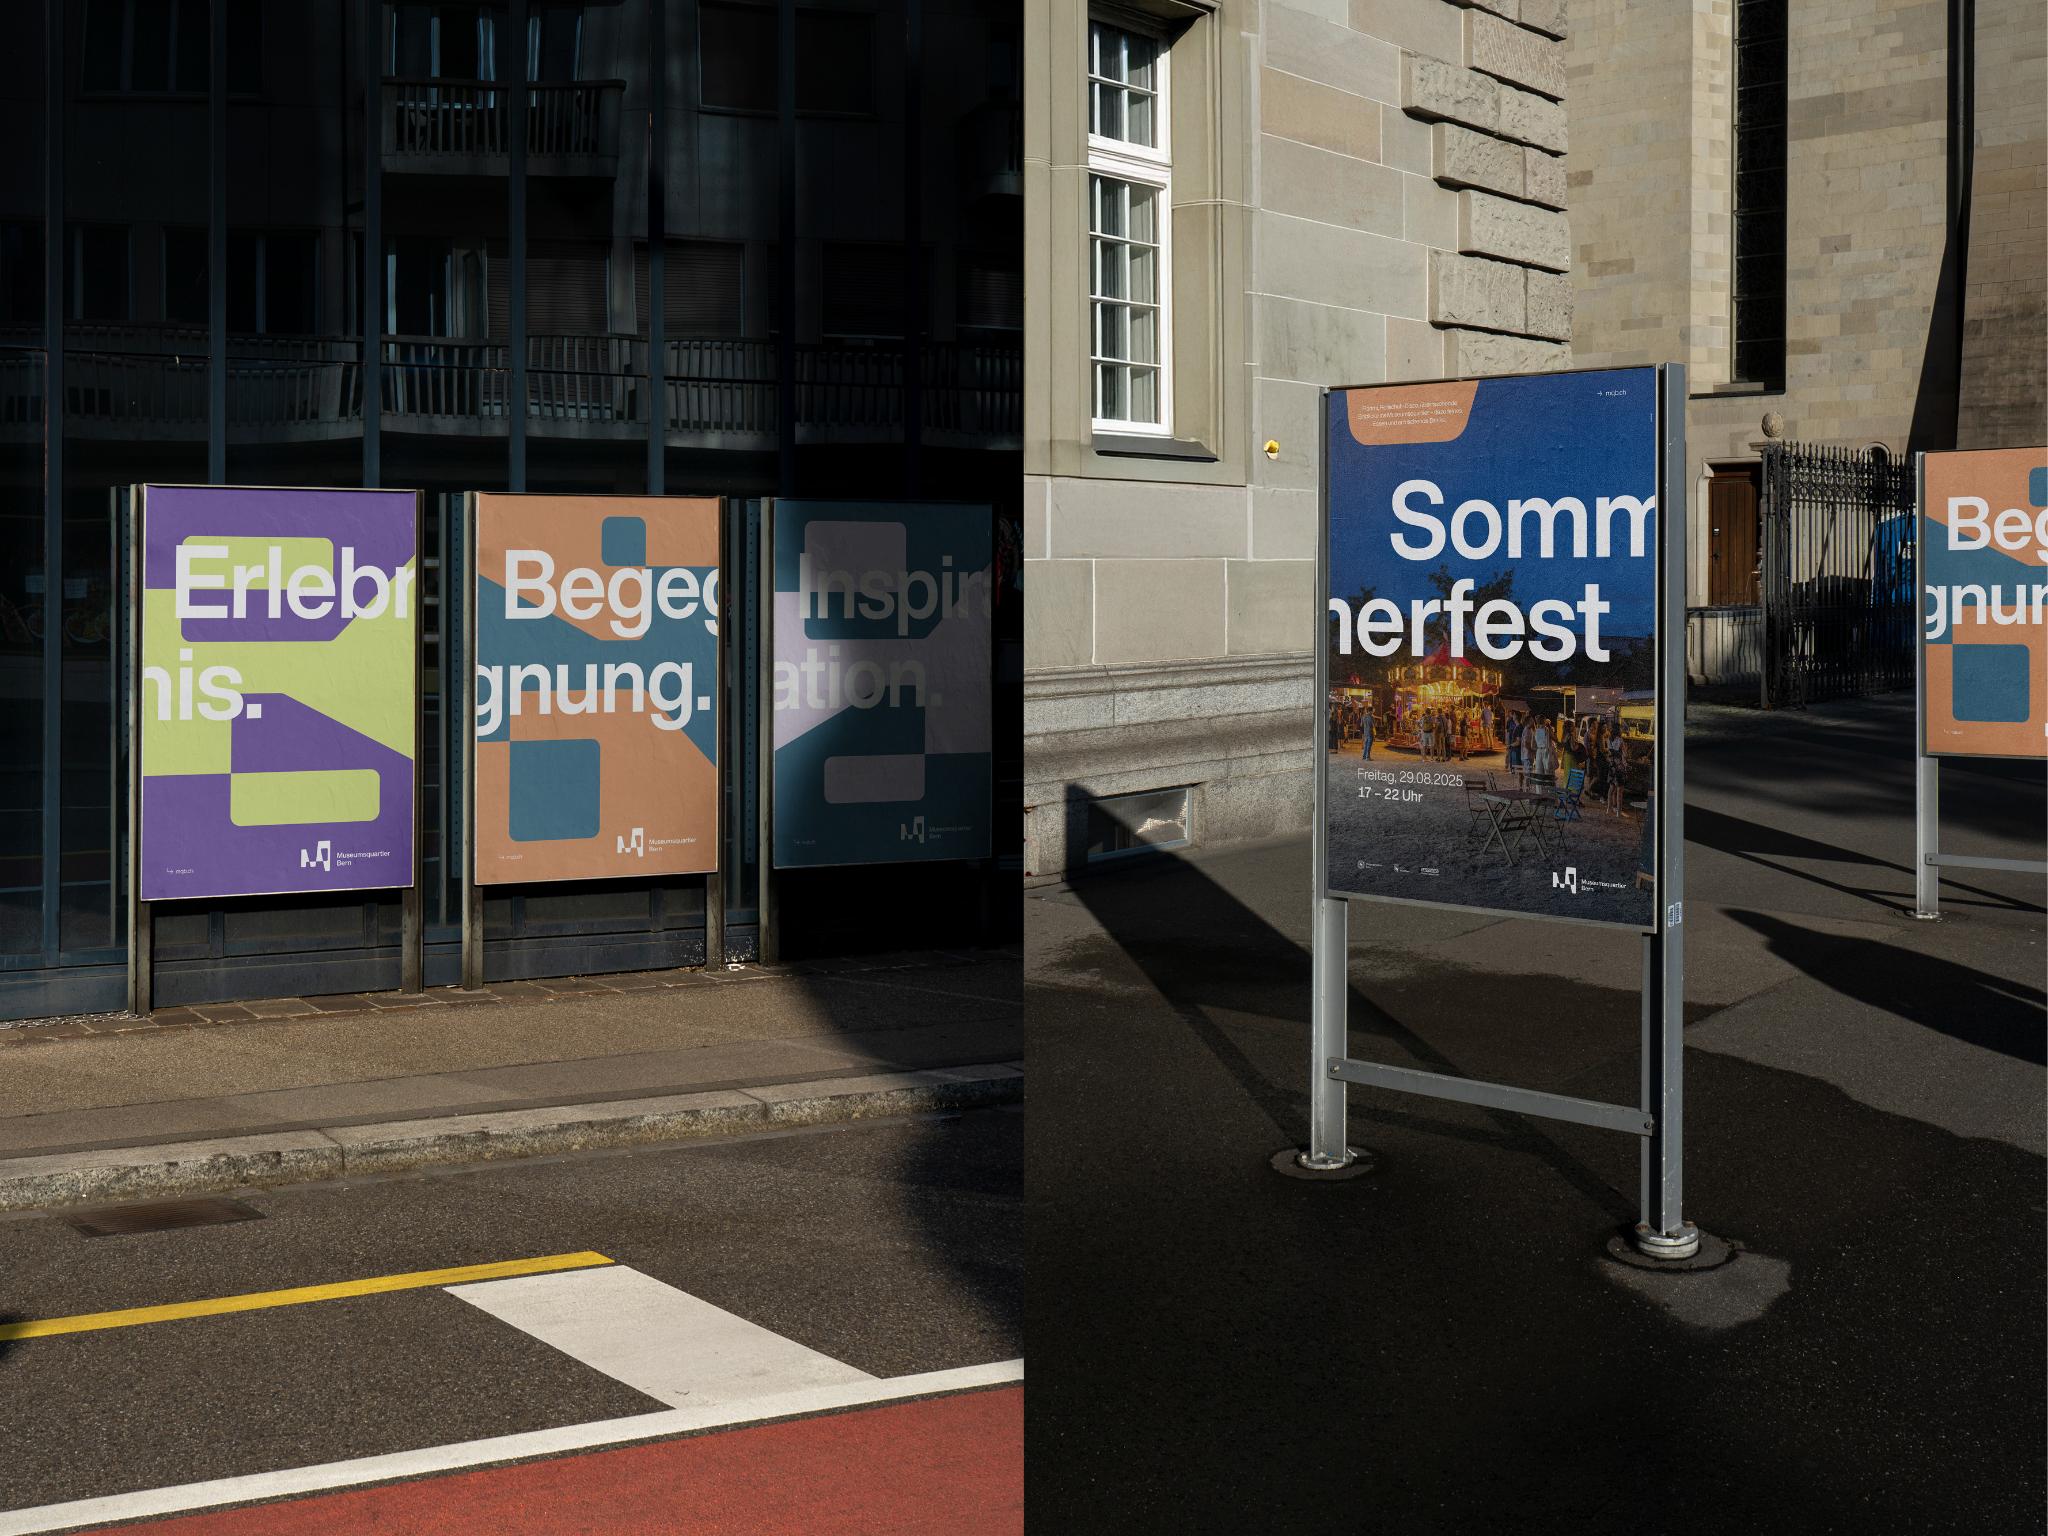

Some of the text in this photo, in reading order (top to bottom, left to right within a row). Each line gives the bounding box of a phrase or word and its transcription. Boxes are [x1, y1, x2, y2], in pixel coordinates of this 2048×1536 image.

[799, 552, 992, 637] Inspir
[1328, 578, 1610, 662] erfest
[1357, 767, 1463, 787] Freitag, 29.08.2025
[1358, 786, 1371, 798] 17
[1384, 788, 1399, 801] 22
[1402, 789, 1423, 803] Uhr
[336, 851, 391, 860] Museumsquartier
